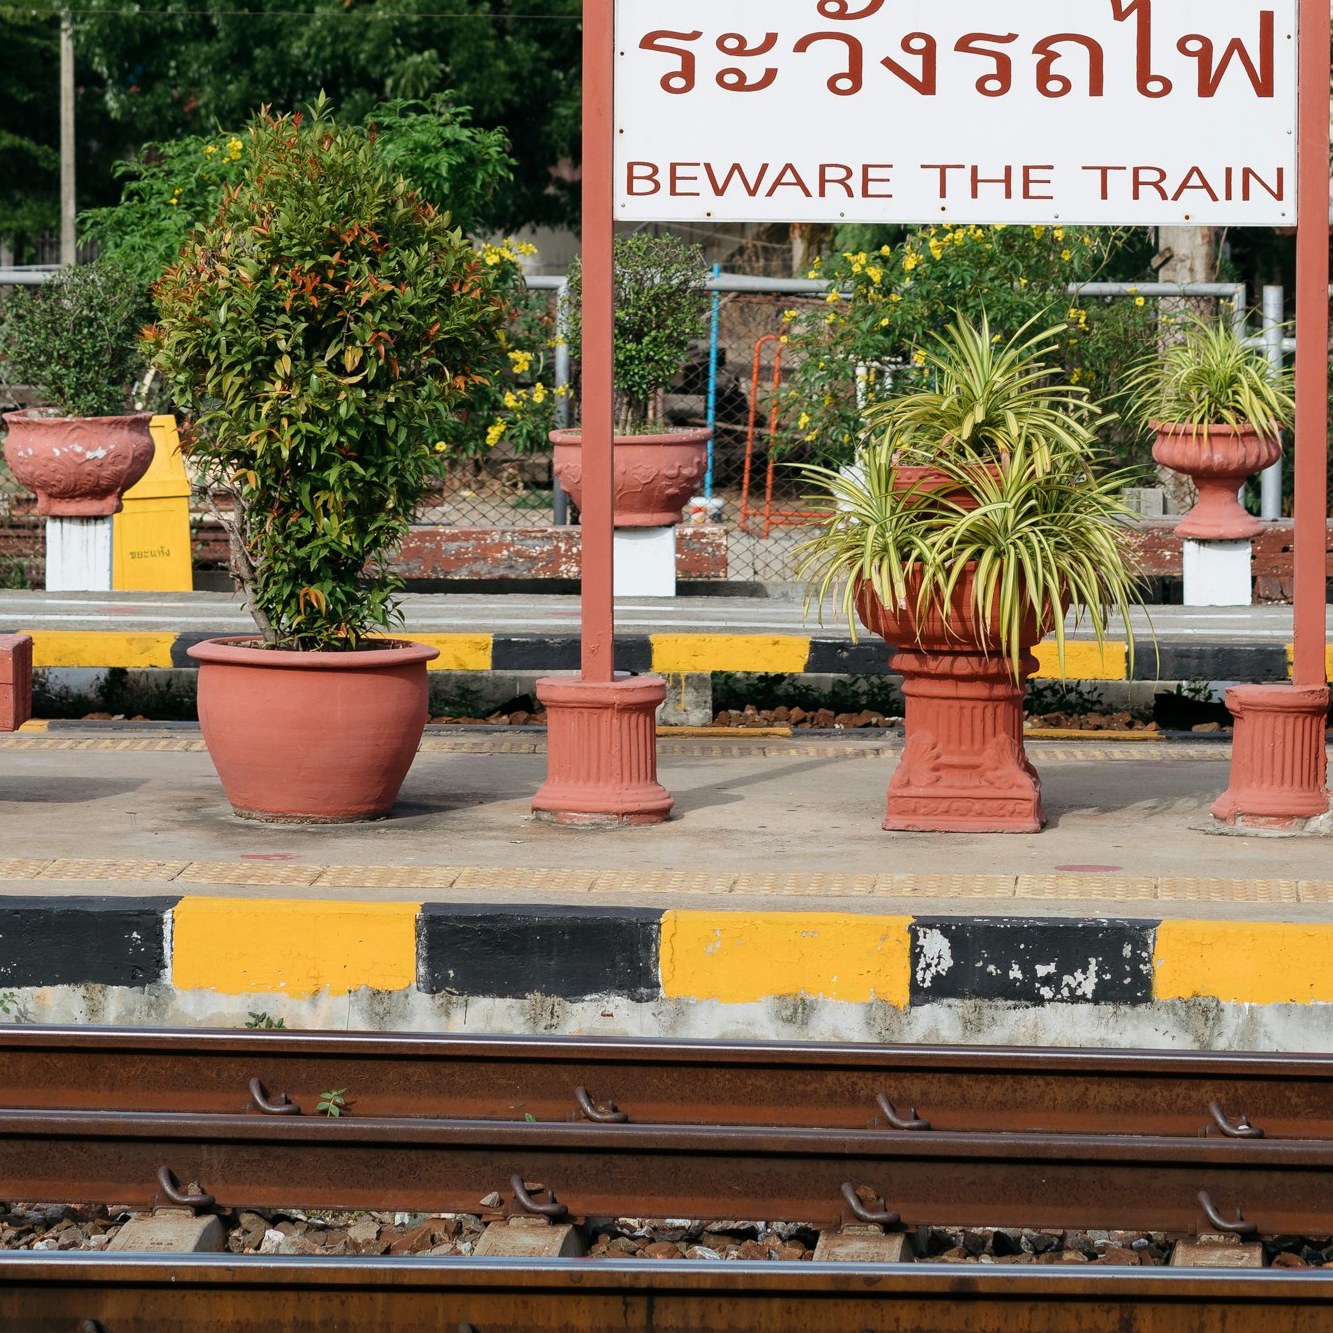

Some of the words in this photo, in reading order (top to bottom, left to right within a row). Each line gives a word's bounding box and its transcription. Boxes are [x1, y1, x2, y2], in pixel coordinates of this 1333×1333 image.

[626, 161, 893, 199] BEWARE
[920, 164, 1054, 200] THE
[1082, 165, 1284, 202] TRAIN
